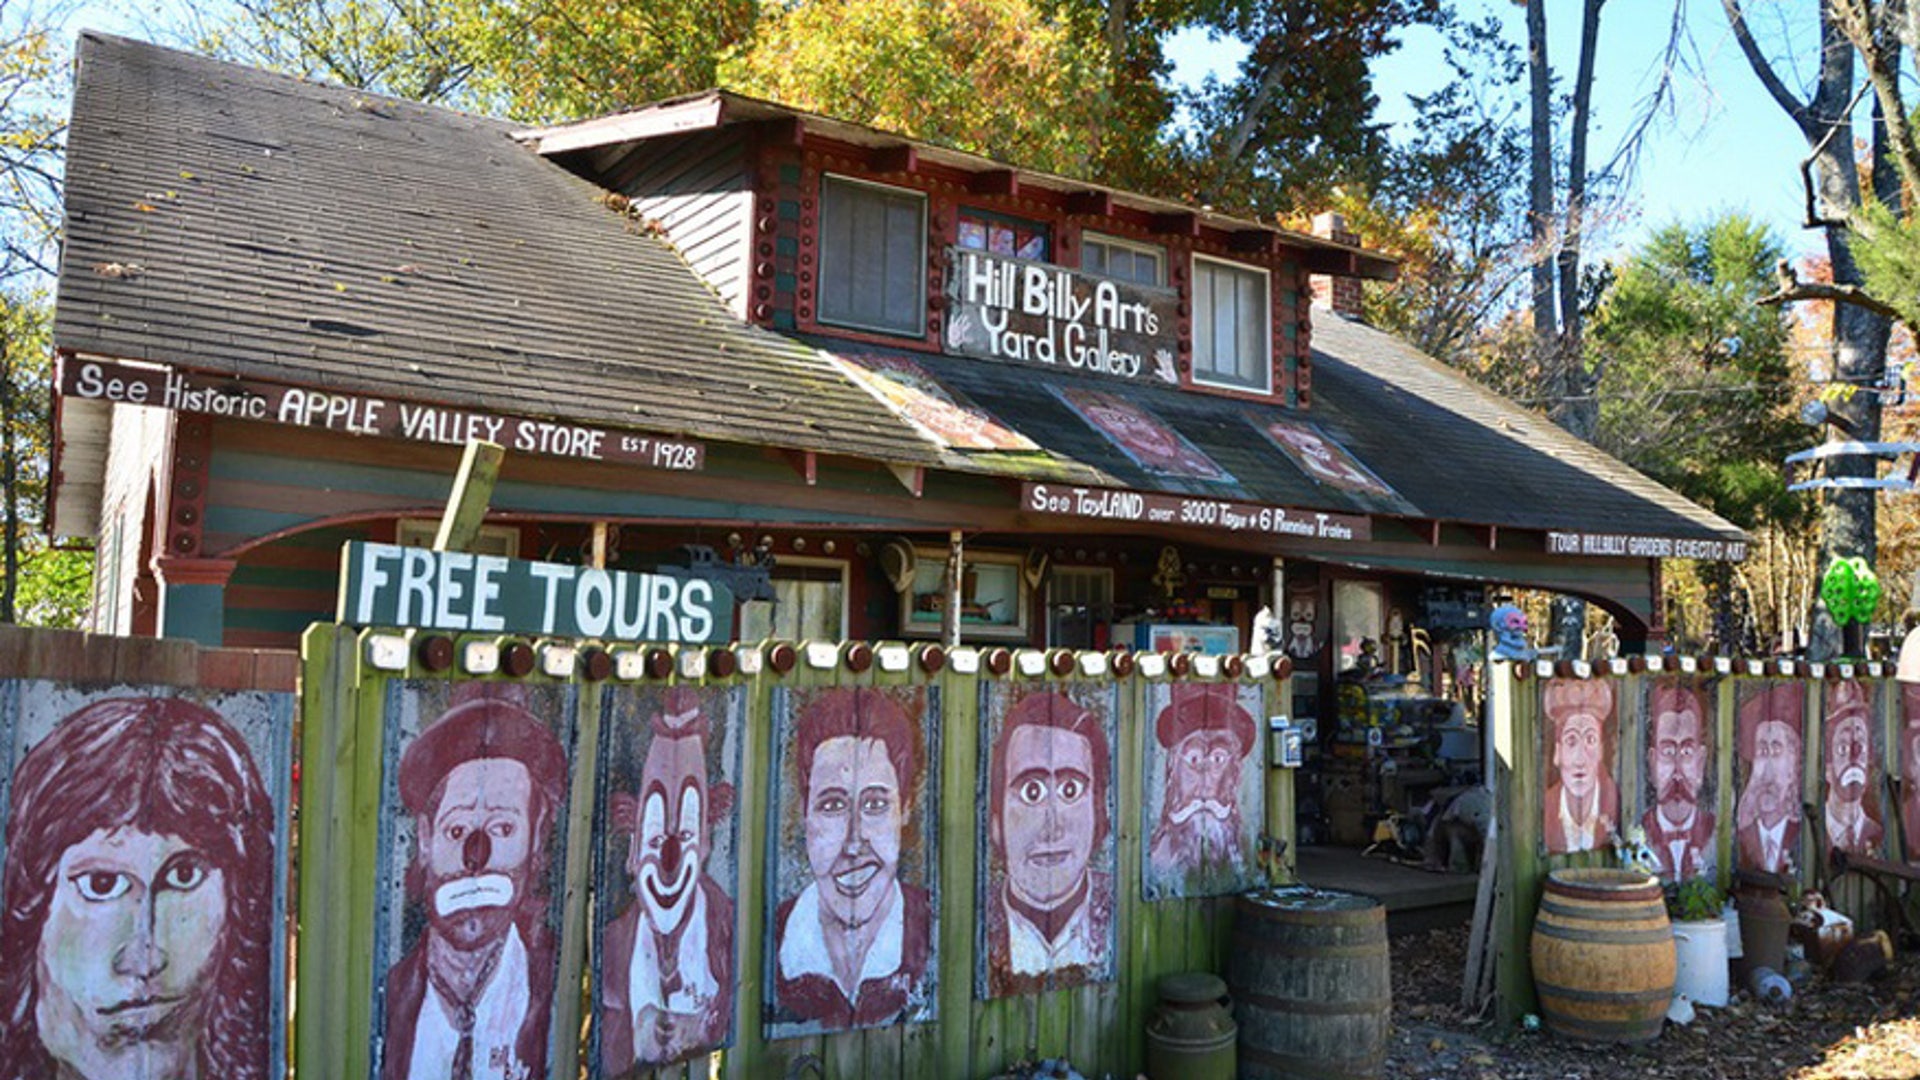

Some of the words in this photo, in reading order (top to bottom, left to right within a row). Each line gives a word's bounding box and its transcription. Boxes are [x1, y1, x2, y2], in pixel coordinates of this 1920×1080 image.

[968, 254, 1017, 310] Hill
[1023, 266, 1092, 321] Billy
[981, 305, 1056, 364] Yard
[1064, 322, 1141, 377] Gallery
[76, 363, 149, 402] See
[164, 371, 266, 419] Historic
[277, 388, 385, 434] APPLE
[400, 404, 504, 445] VALLEY
[515, 420, 606, 459] STORE
[621, 436, 649, 453] EST
[653, 441, 697, 470] 1928
[1031, 485, 1070, 512] See
[1073, 488, 1144, 520] ToyLAND
[1180, 500, 1217, 524] 3000
[1259, 508, 1271, 531] 6
[1315, 513, 1352, 540] Trains
[1548, 532, 1580, 553] TOUR
[1724, 541, 1747, 561] ART
[357, 543, 509, 631] FREE
[530, 561, 713, 642] TOURS
